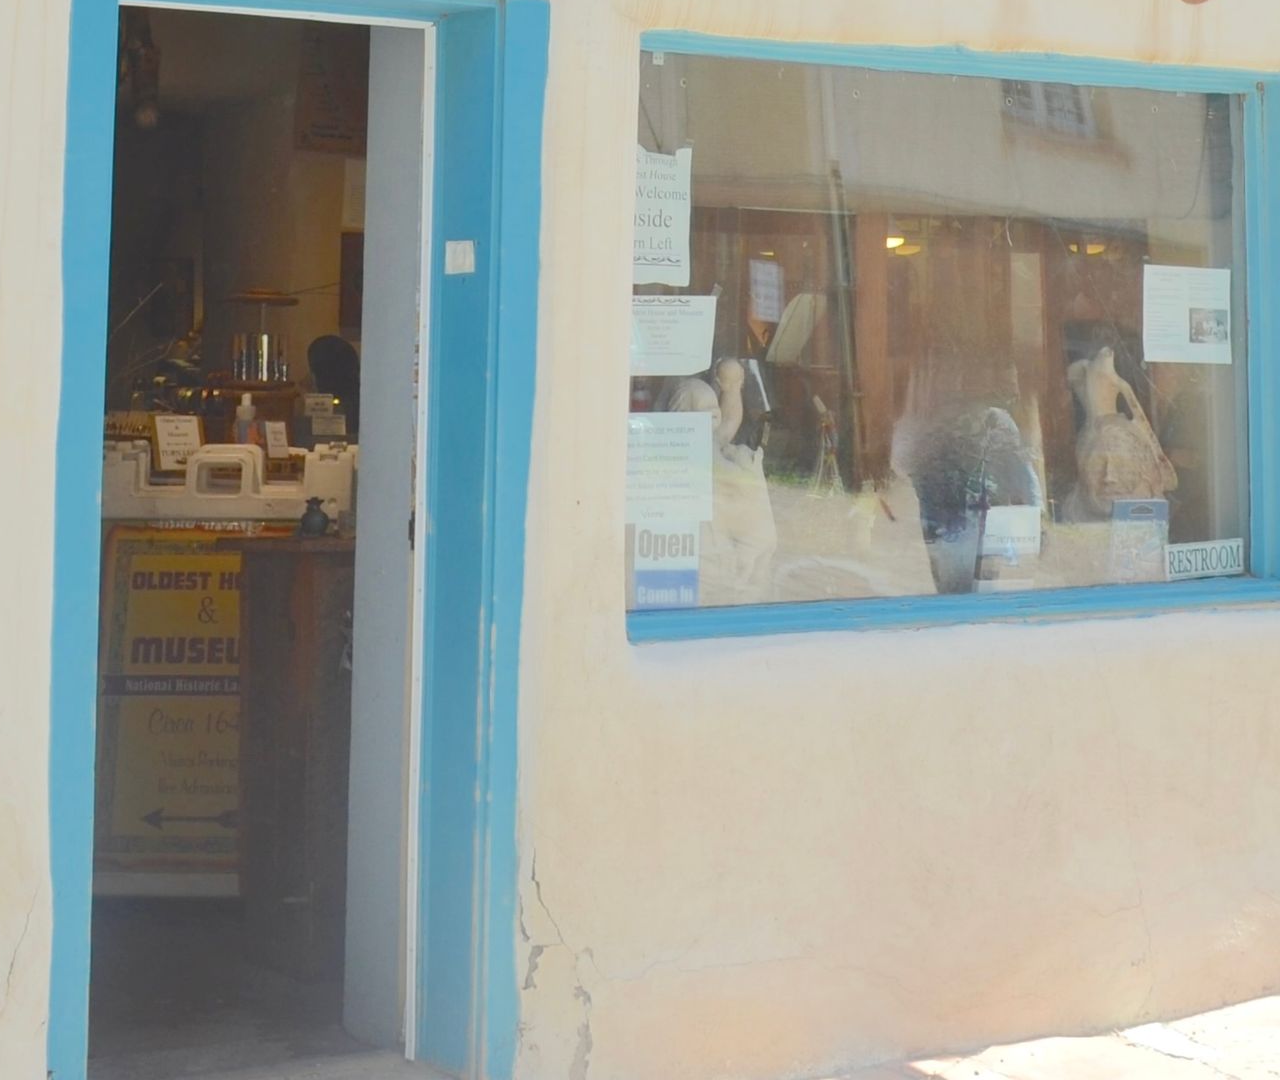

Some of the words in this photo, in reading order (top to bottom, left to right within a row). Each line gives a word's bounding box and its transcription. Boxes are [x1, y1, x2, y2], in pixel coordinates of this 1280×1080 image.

[649, 169, 677, 182] House
[635, 184, 688, 201] Welcome
[649, 236, 673, 250] Left
[638, 529, 695, 561] Open
[1168, 544, 1241, 575] RESTROOM
[131, 571, 213, 591] OLDEST
[637, 585, 678, 605] Come
[196, 596, 220, 625] &
[125, 679, 173, 692] National
[175, 678, 222, 692] Historic
